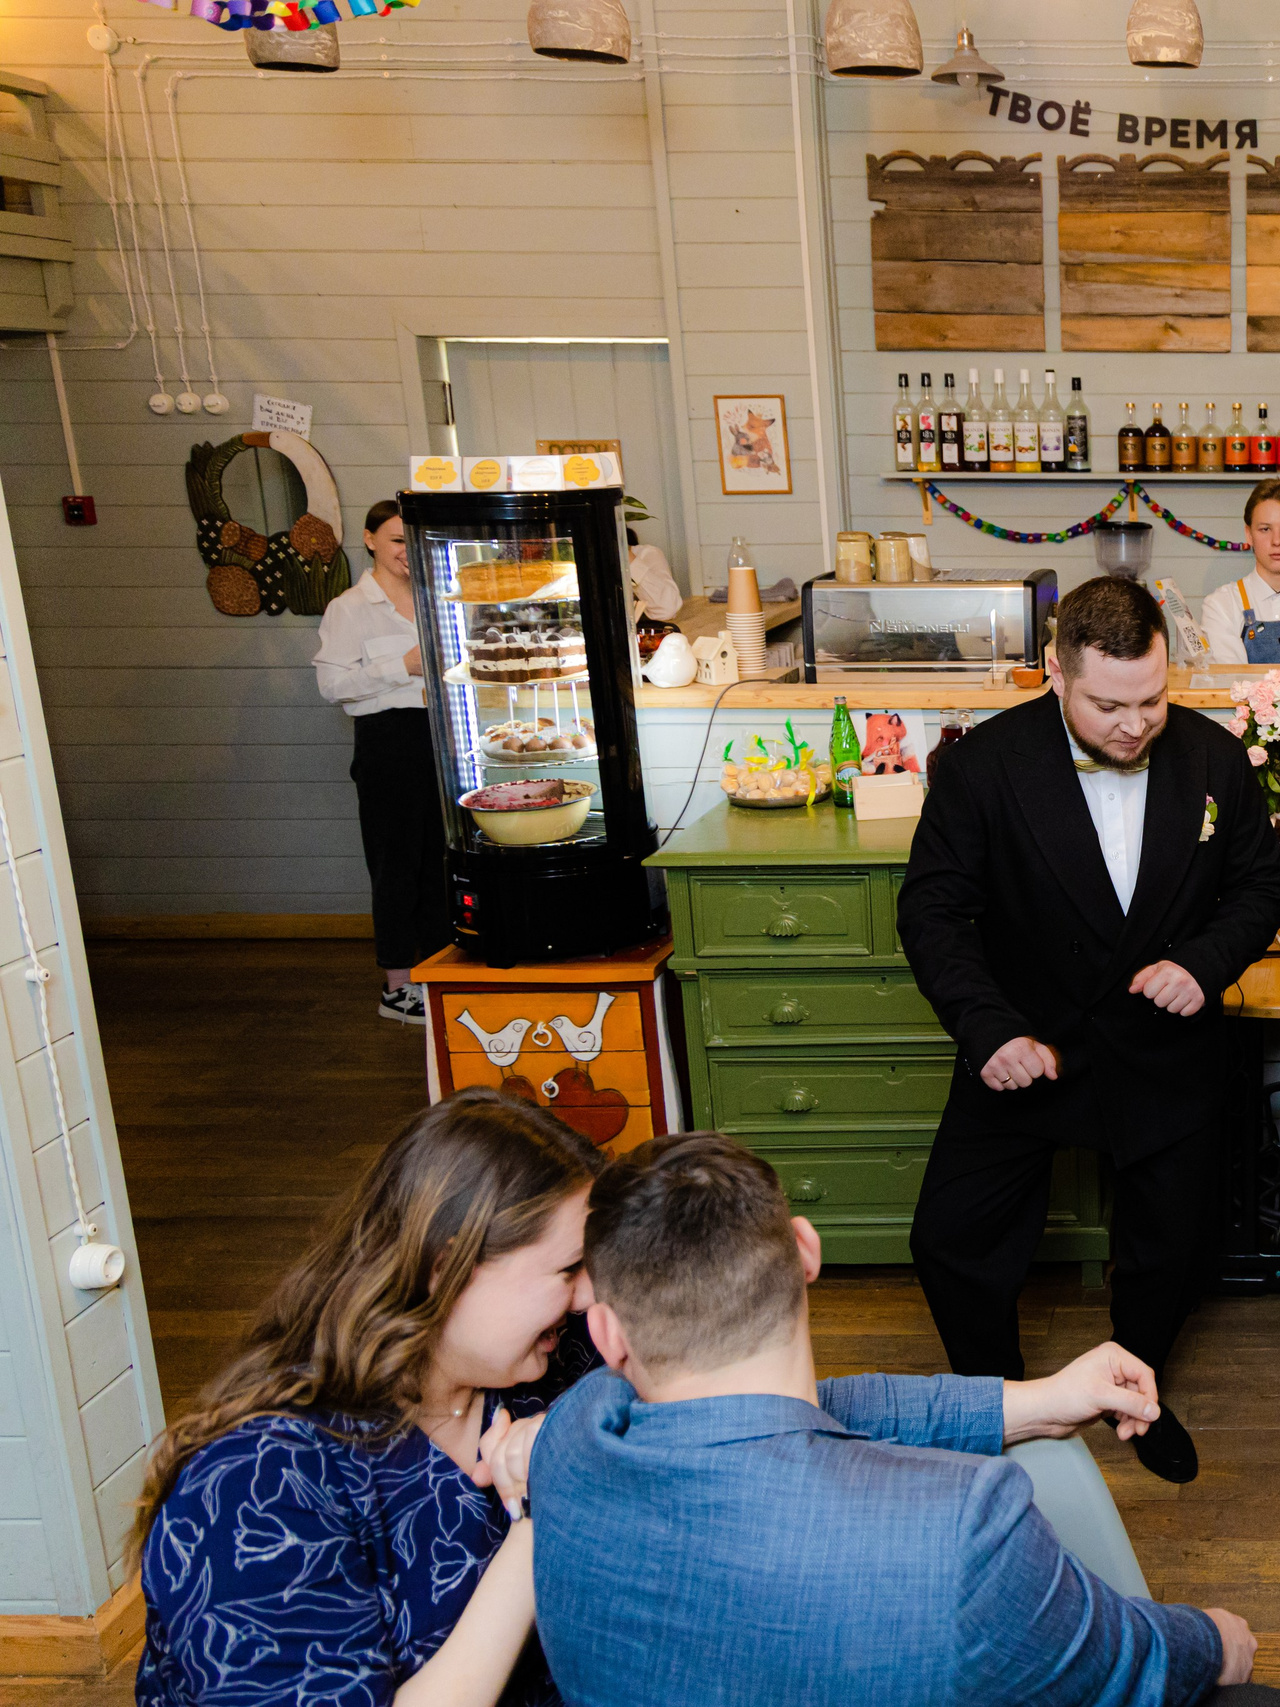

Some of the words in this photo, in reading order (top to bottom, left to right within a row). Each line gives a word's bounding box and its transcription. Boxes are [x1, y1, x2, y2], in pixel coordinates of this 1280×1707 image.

[986, 85, 1093, 137] ТВОЁ
[1117, 113, 1259, 149] ВРЕМЯ
[886, 623, 970, 634] SIMONELLI
